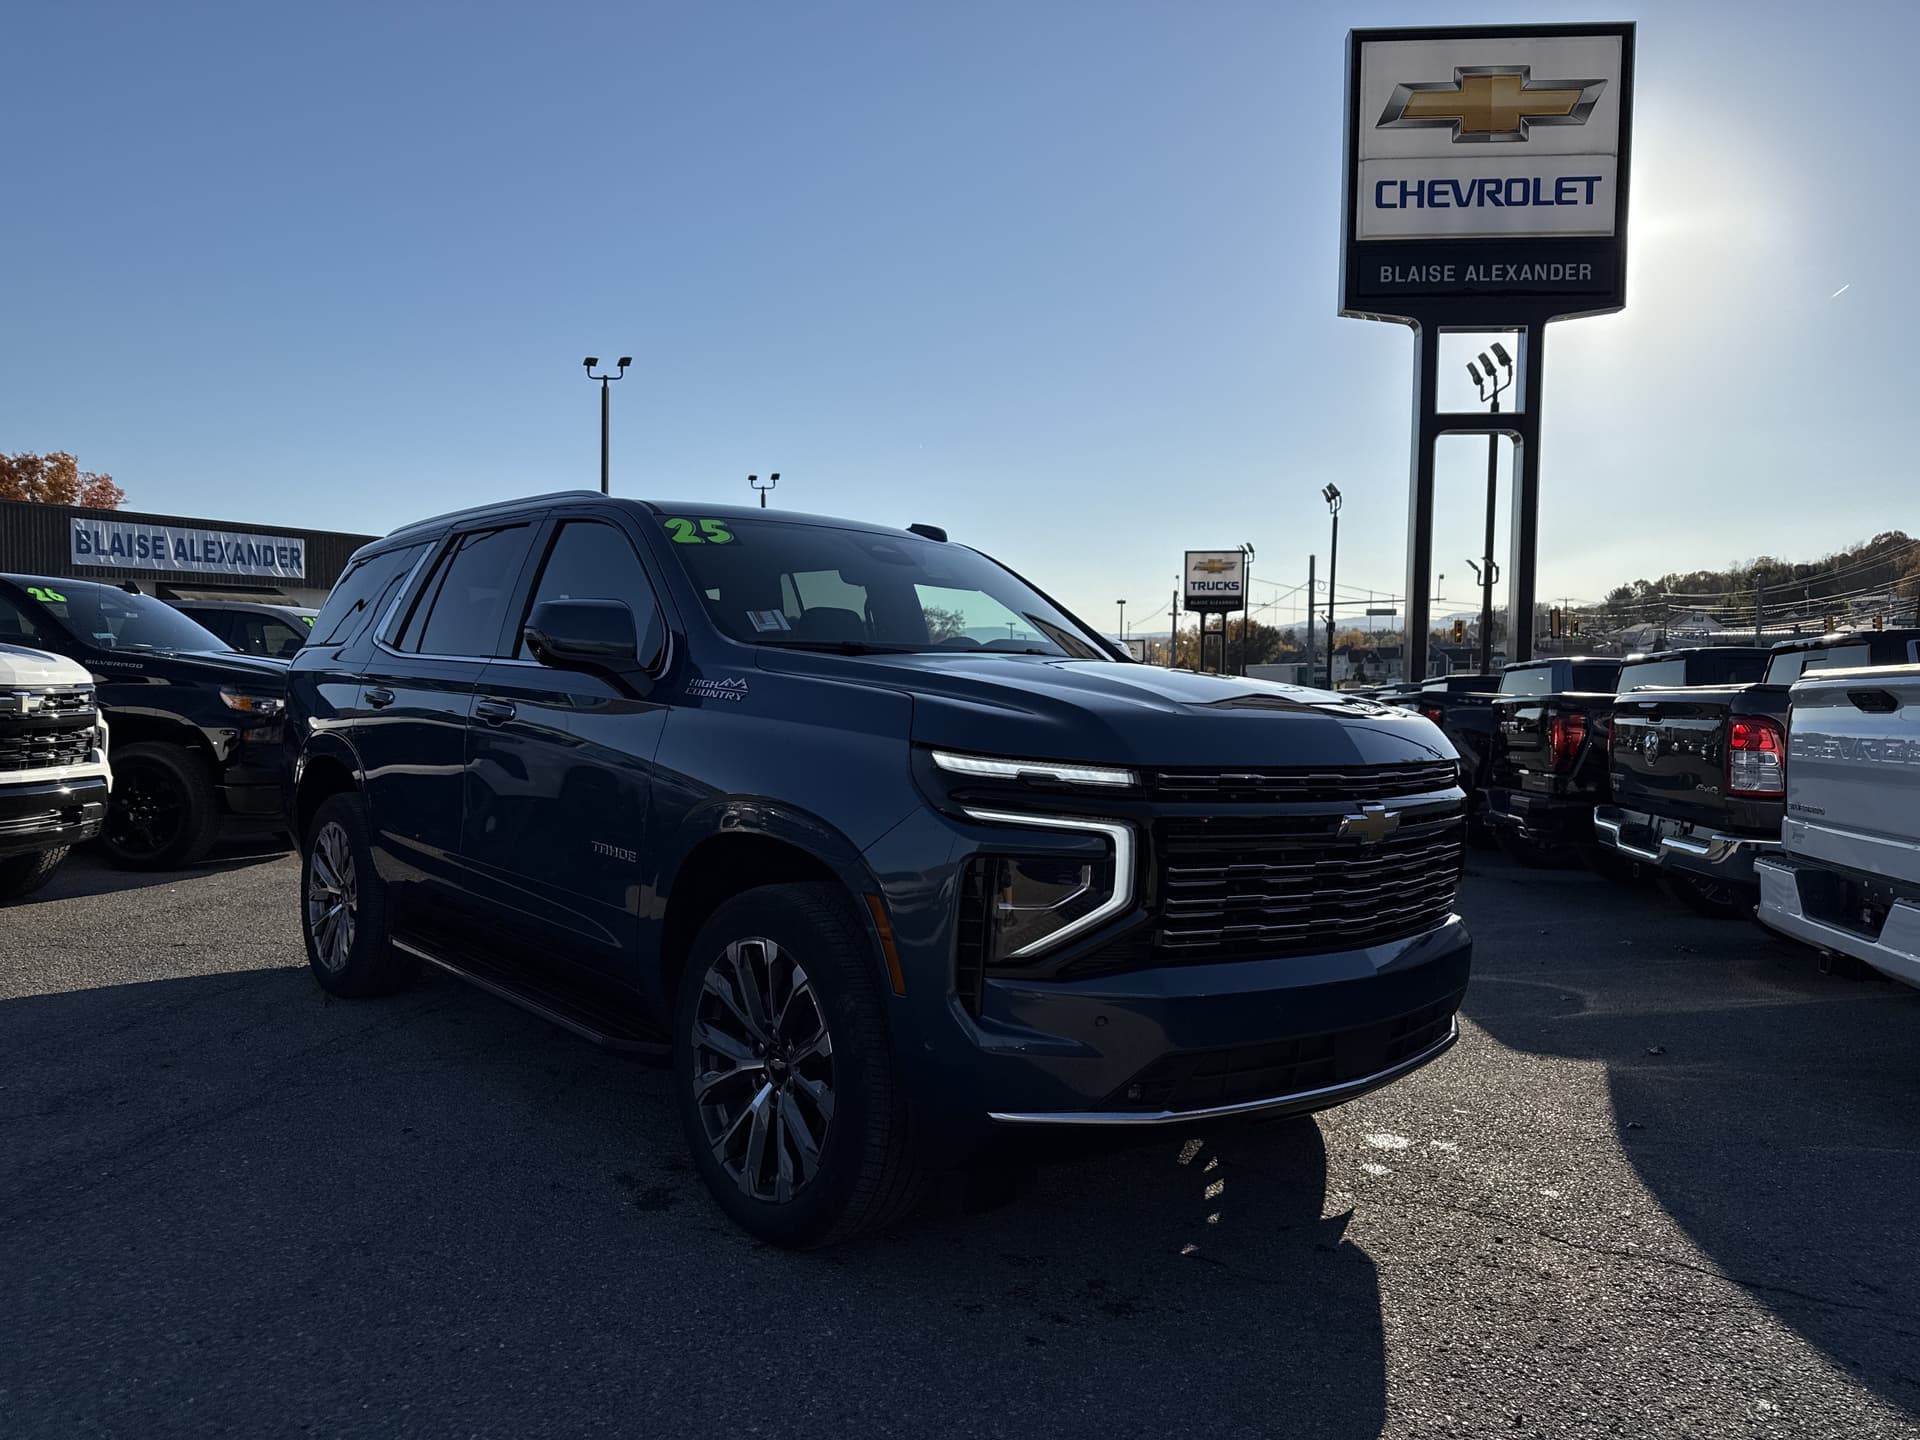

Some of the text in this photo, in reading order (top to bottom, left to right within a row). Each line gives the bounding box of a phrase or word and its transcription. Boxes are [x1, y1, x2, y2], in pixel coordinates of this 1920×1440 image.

[1375, 176, 1602, 209] CHEVROLET
[1379, 263, 1592, 283] BLAISE ALEXANDER
[663, 517, 735, 544] 25
[75, 529, 303, 569] BLAISE ALEXANDER
[26, 586, 68, 602] 26
[1190, 581, 1239, 591] TRUCKS
[689, 678, 719, 688] HIGH
[684, 687, 746, 701] COUNTRY
[591, 840, 638, 863] TAHOE
